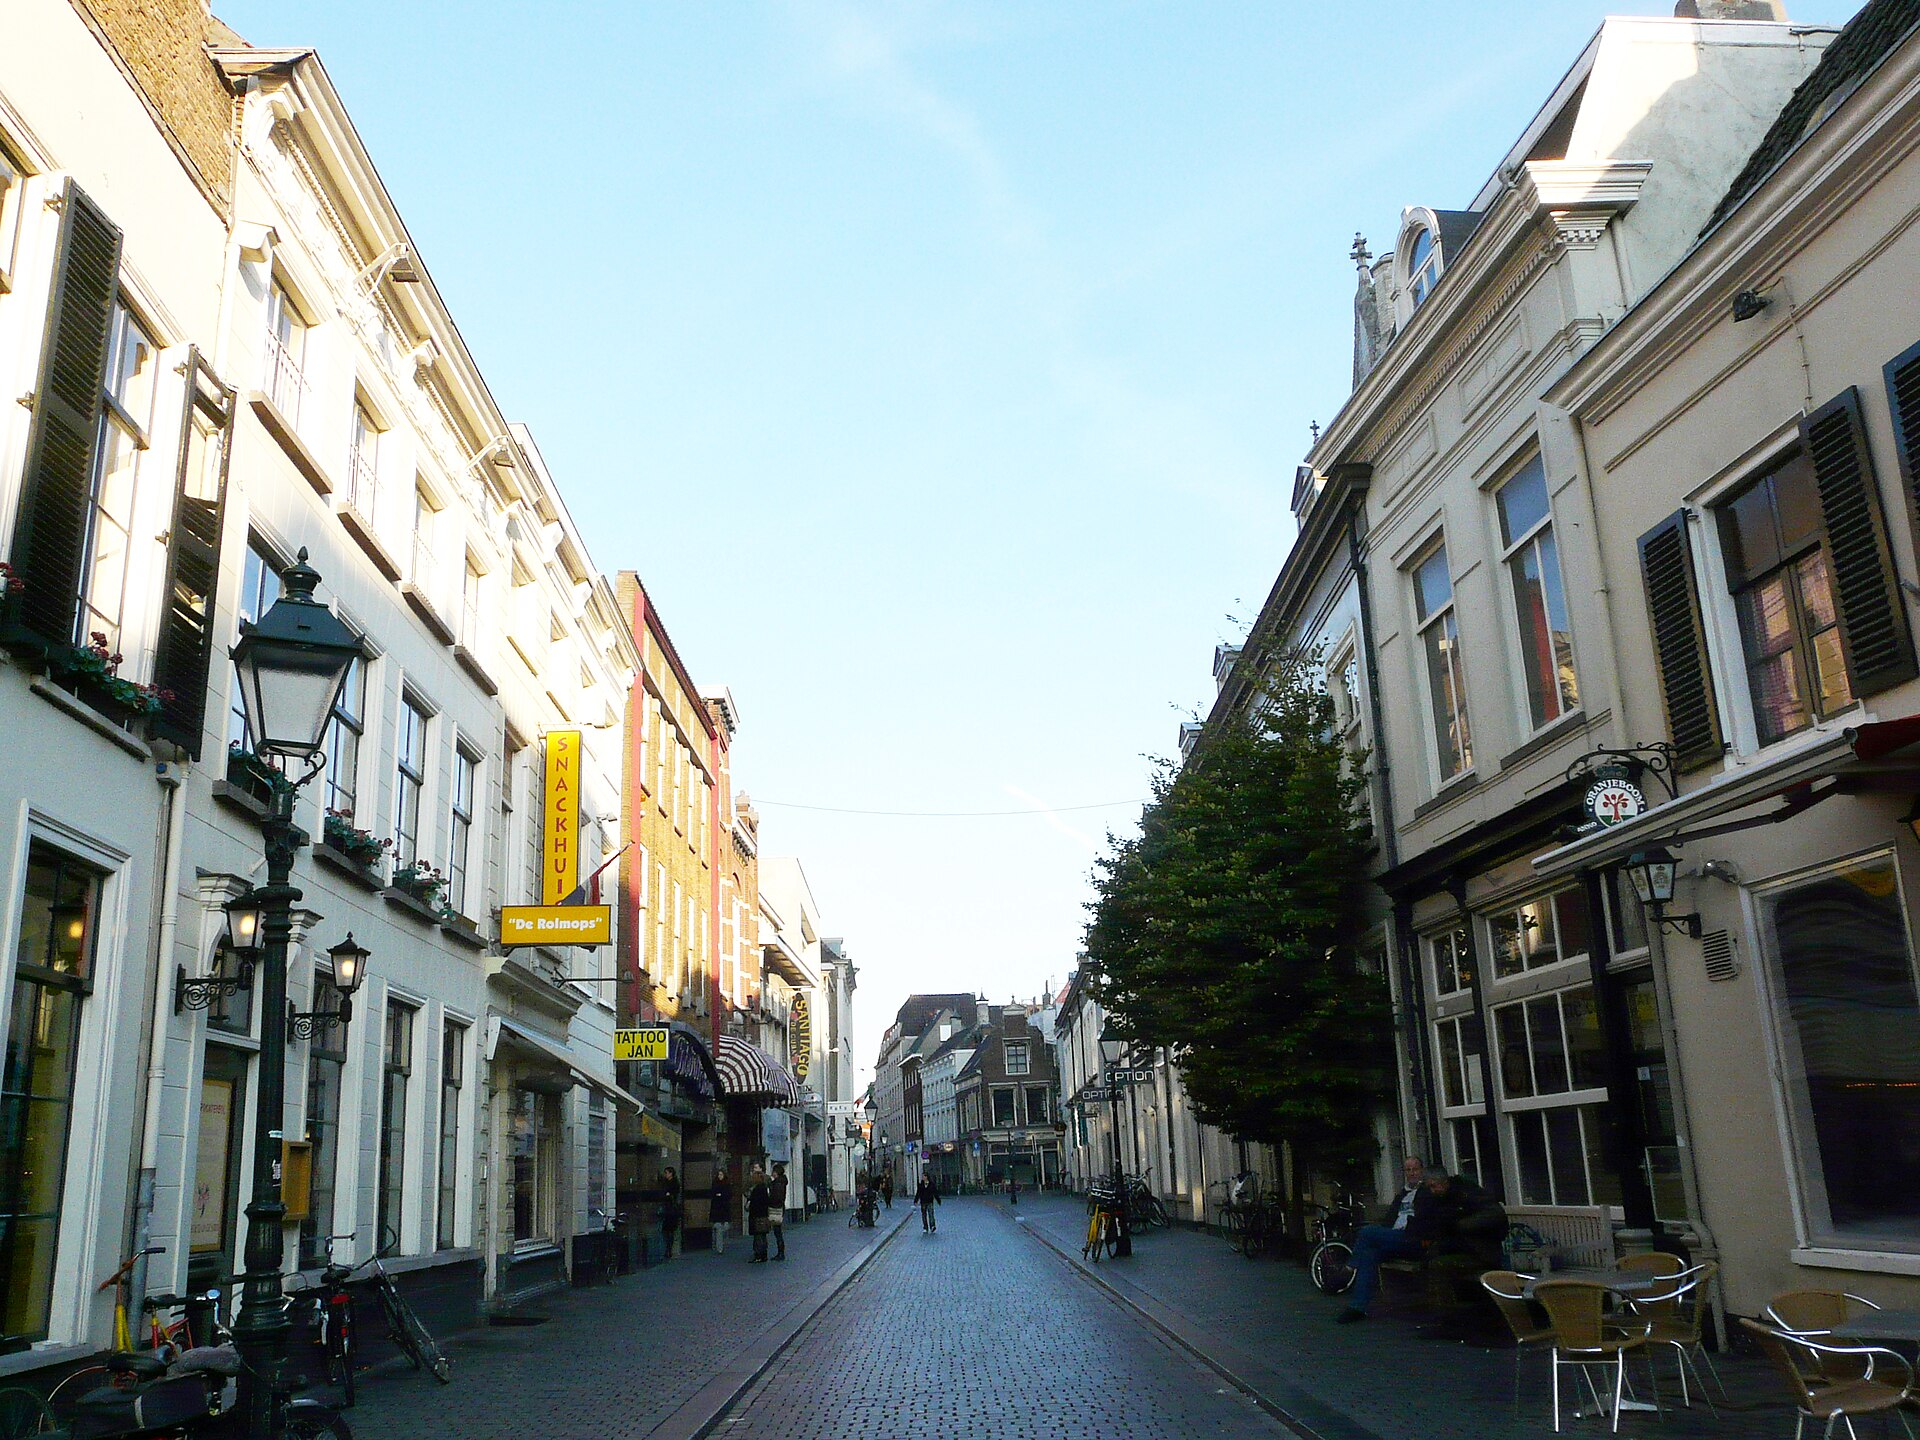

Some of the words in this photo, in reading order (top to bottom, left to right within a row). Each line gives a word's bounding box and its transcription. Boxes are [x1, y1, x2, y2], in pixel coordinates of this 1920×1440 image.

[1586, 779, 1645, 806] ORANJEBOOM
[553, 736, 569, 905] SNACKHUI
[615, 1031, 666, 1044] TATTOO
[795, 1000, 811, 1076] SANTIAGO
[627, 1045, 654, 1058] JAN
